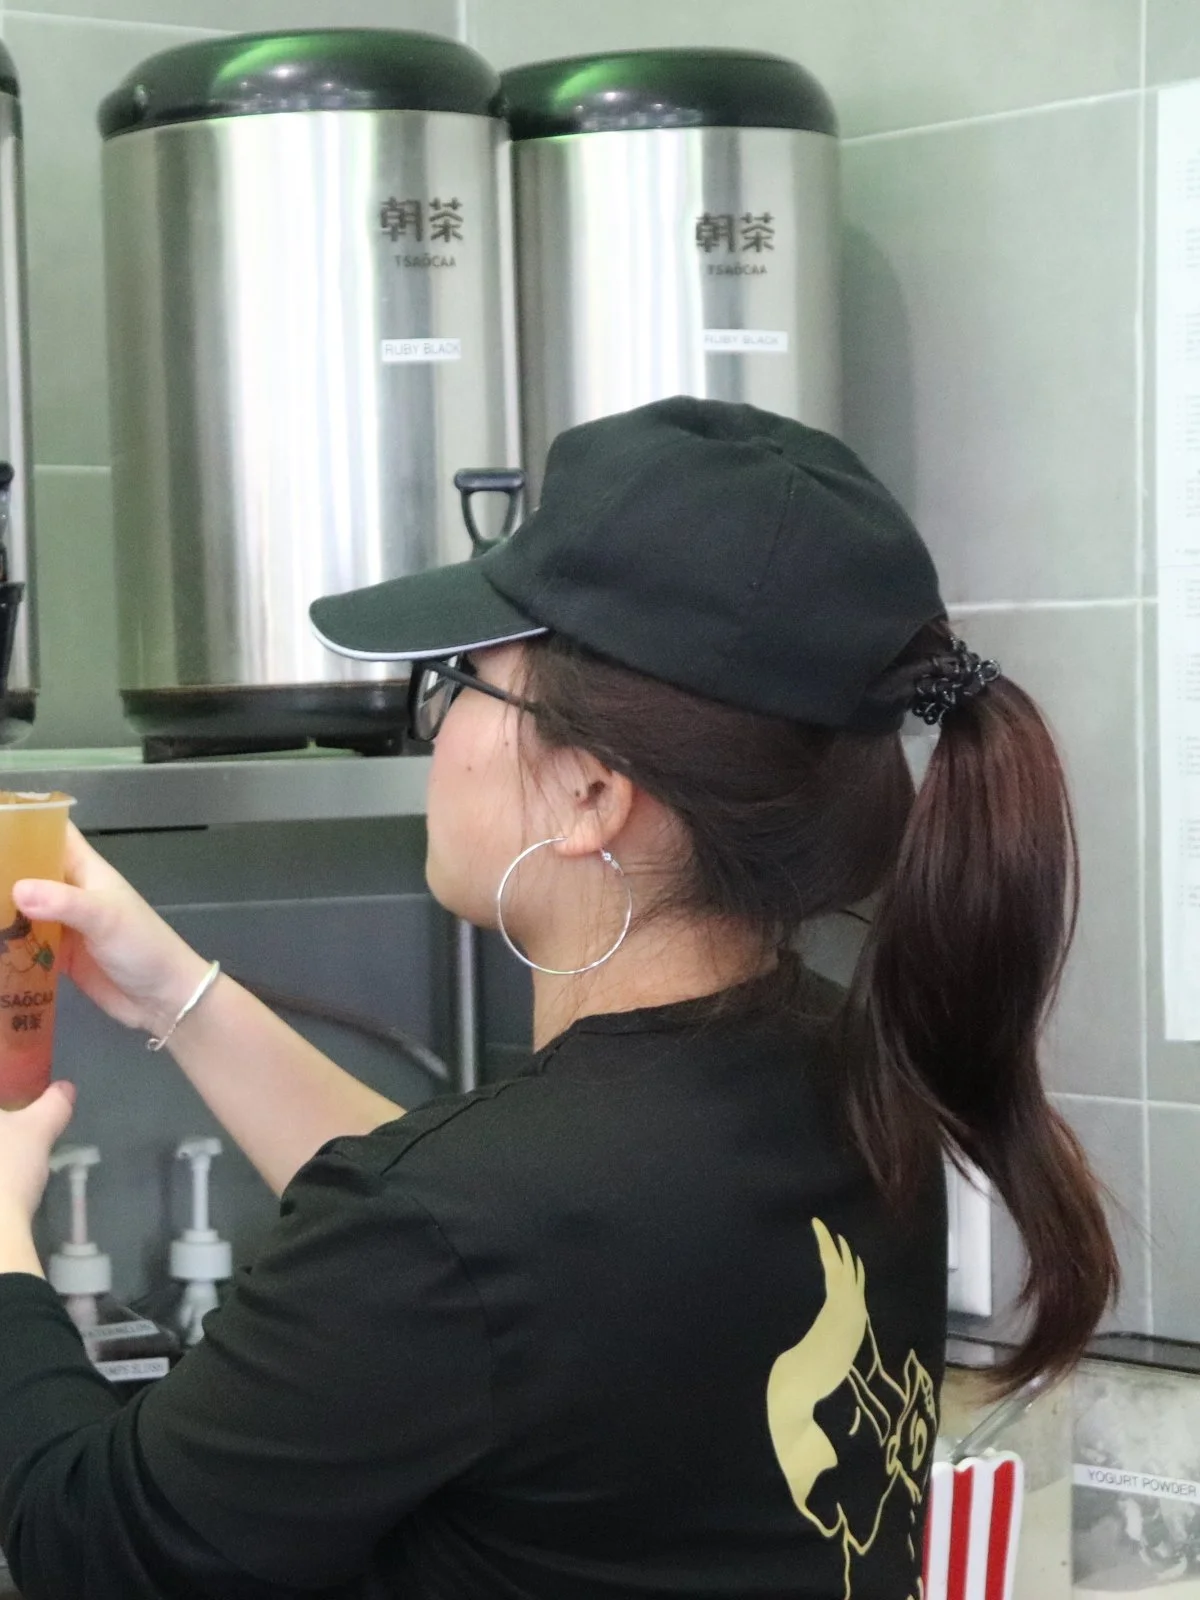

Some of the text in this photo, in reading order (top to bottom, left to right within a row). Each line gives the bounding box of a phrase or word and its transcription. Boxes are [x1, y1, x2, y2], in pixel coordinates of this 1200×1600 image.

[379, 196, 464, 243] 朝茶
[695, 212, 775, 253] 朝茶
[385, 343, 420, 356] RUBY
[1086, 1467, 1197, 1497] YOGURT POWDER
